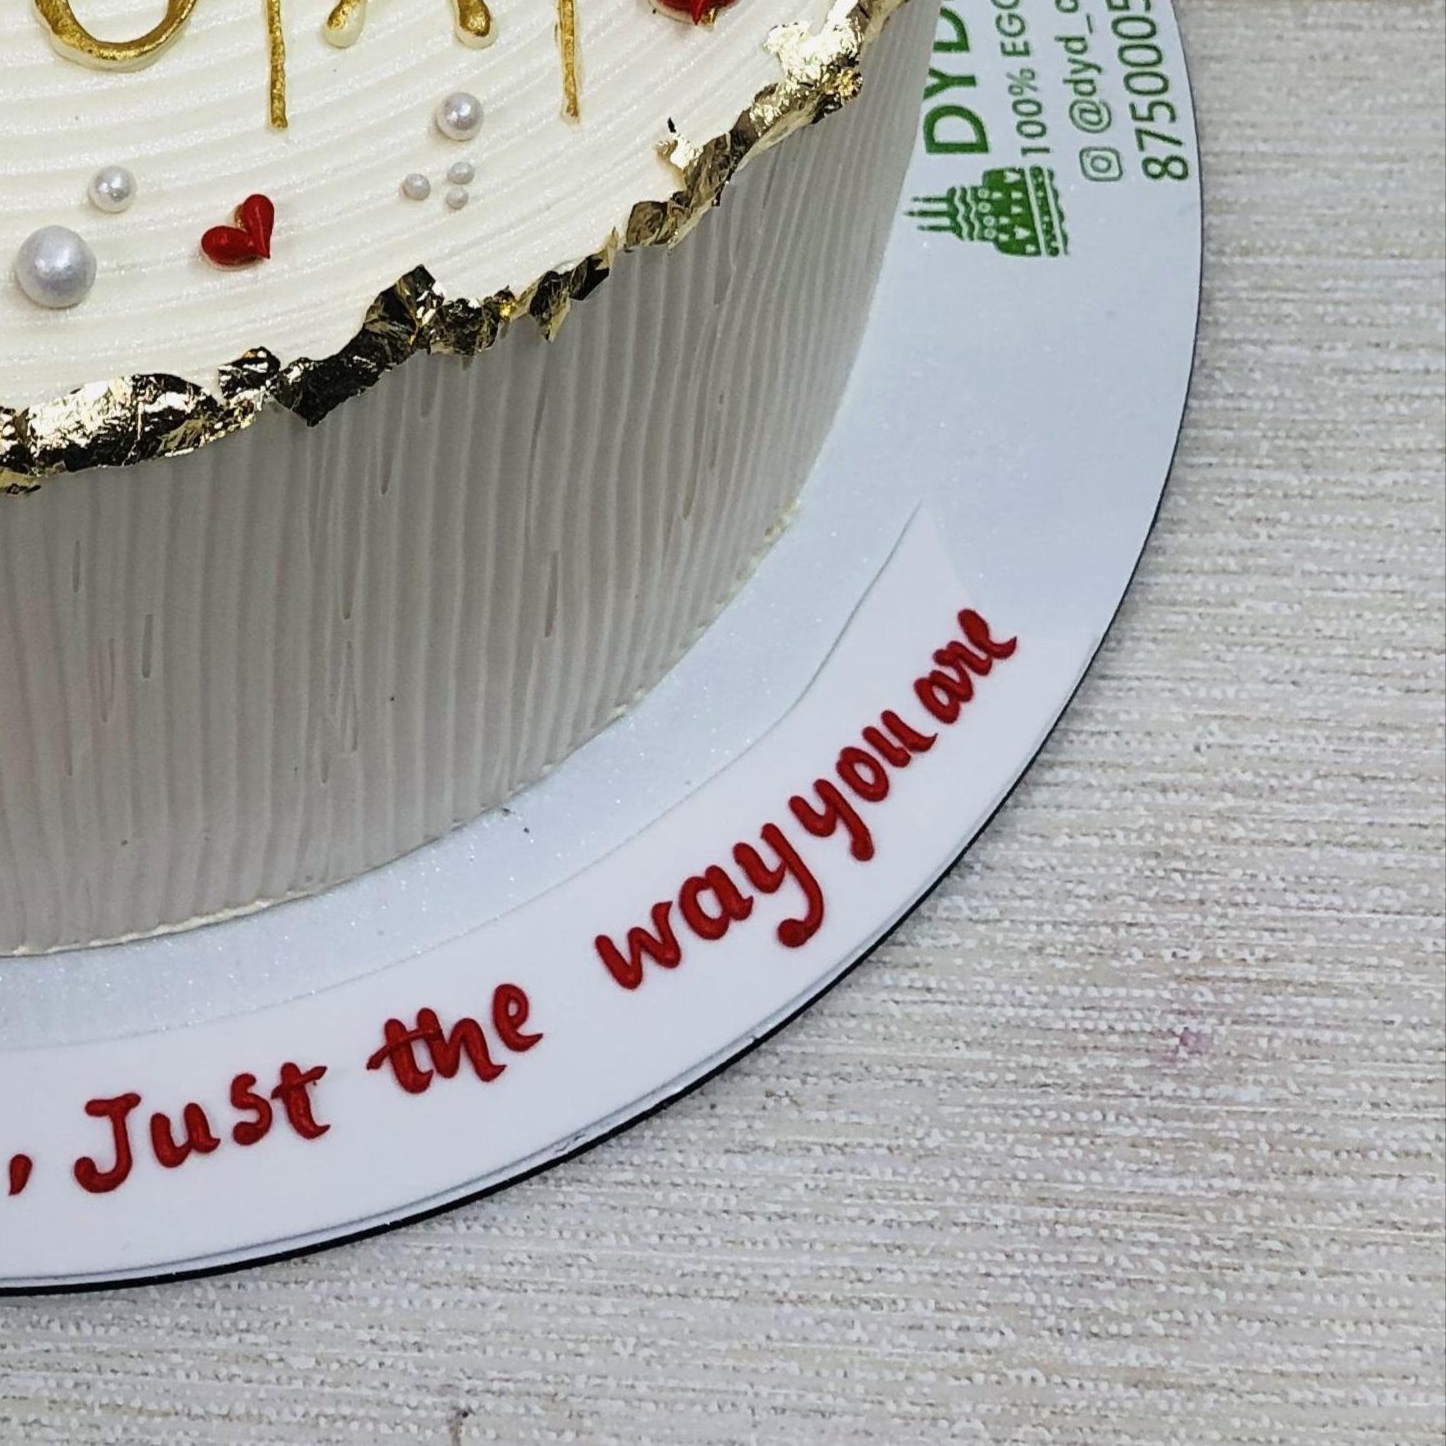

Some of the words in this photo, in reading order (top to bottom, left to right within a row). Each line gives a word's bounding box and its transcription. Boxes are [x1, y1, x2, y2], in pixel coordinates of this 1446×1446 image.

[922, 7, 989, 154] DYD
[1005, 67, 1052, 157] 100%
[73, 1061, 331, 1194] Just
[366, 983, 544, 1094] the
[594, 822, 825, 991] way
[788, 709, 939, 862] you
[912, 608, 1018, 725] are
